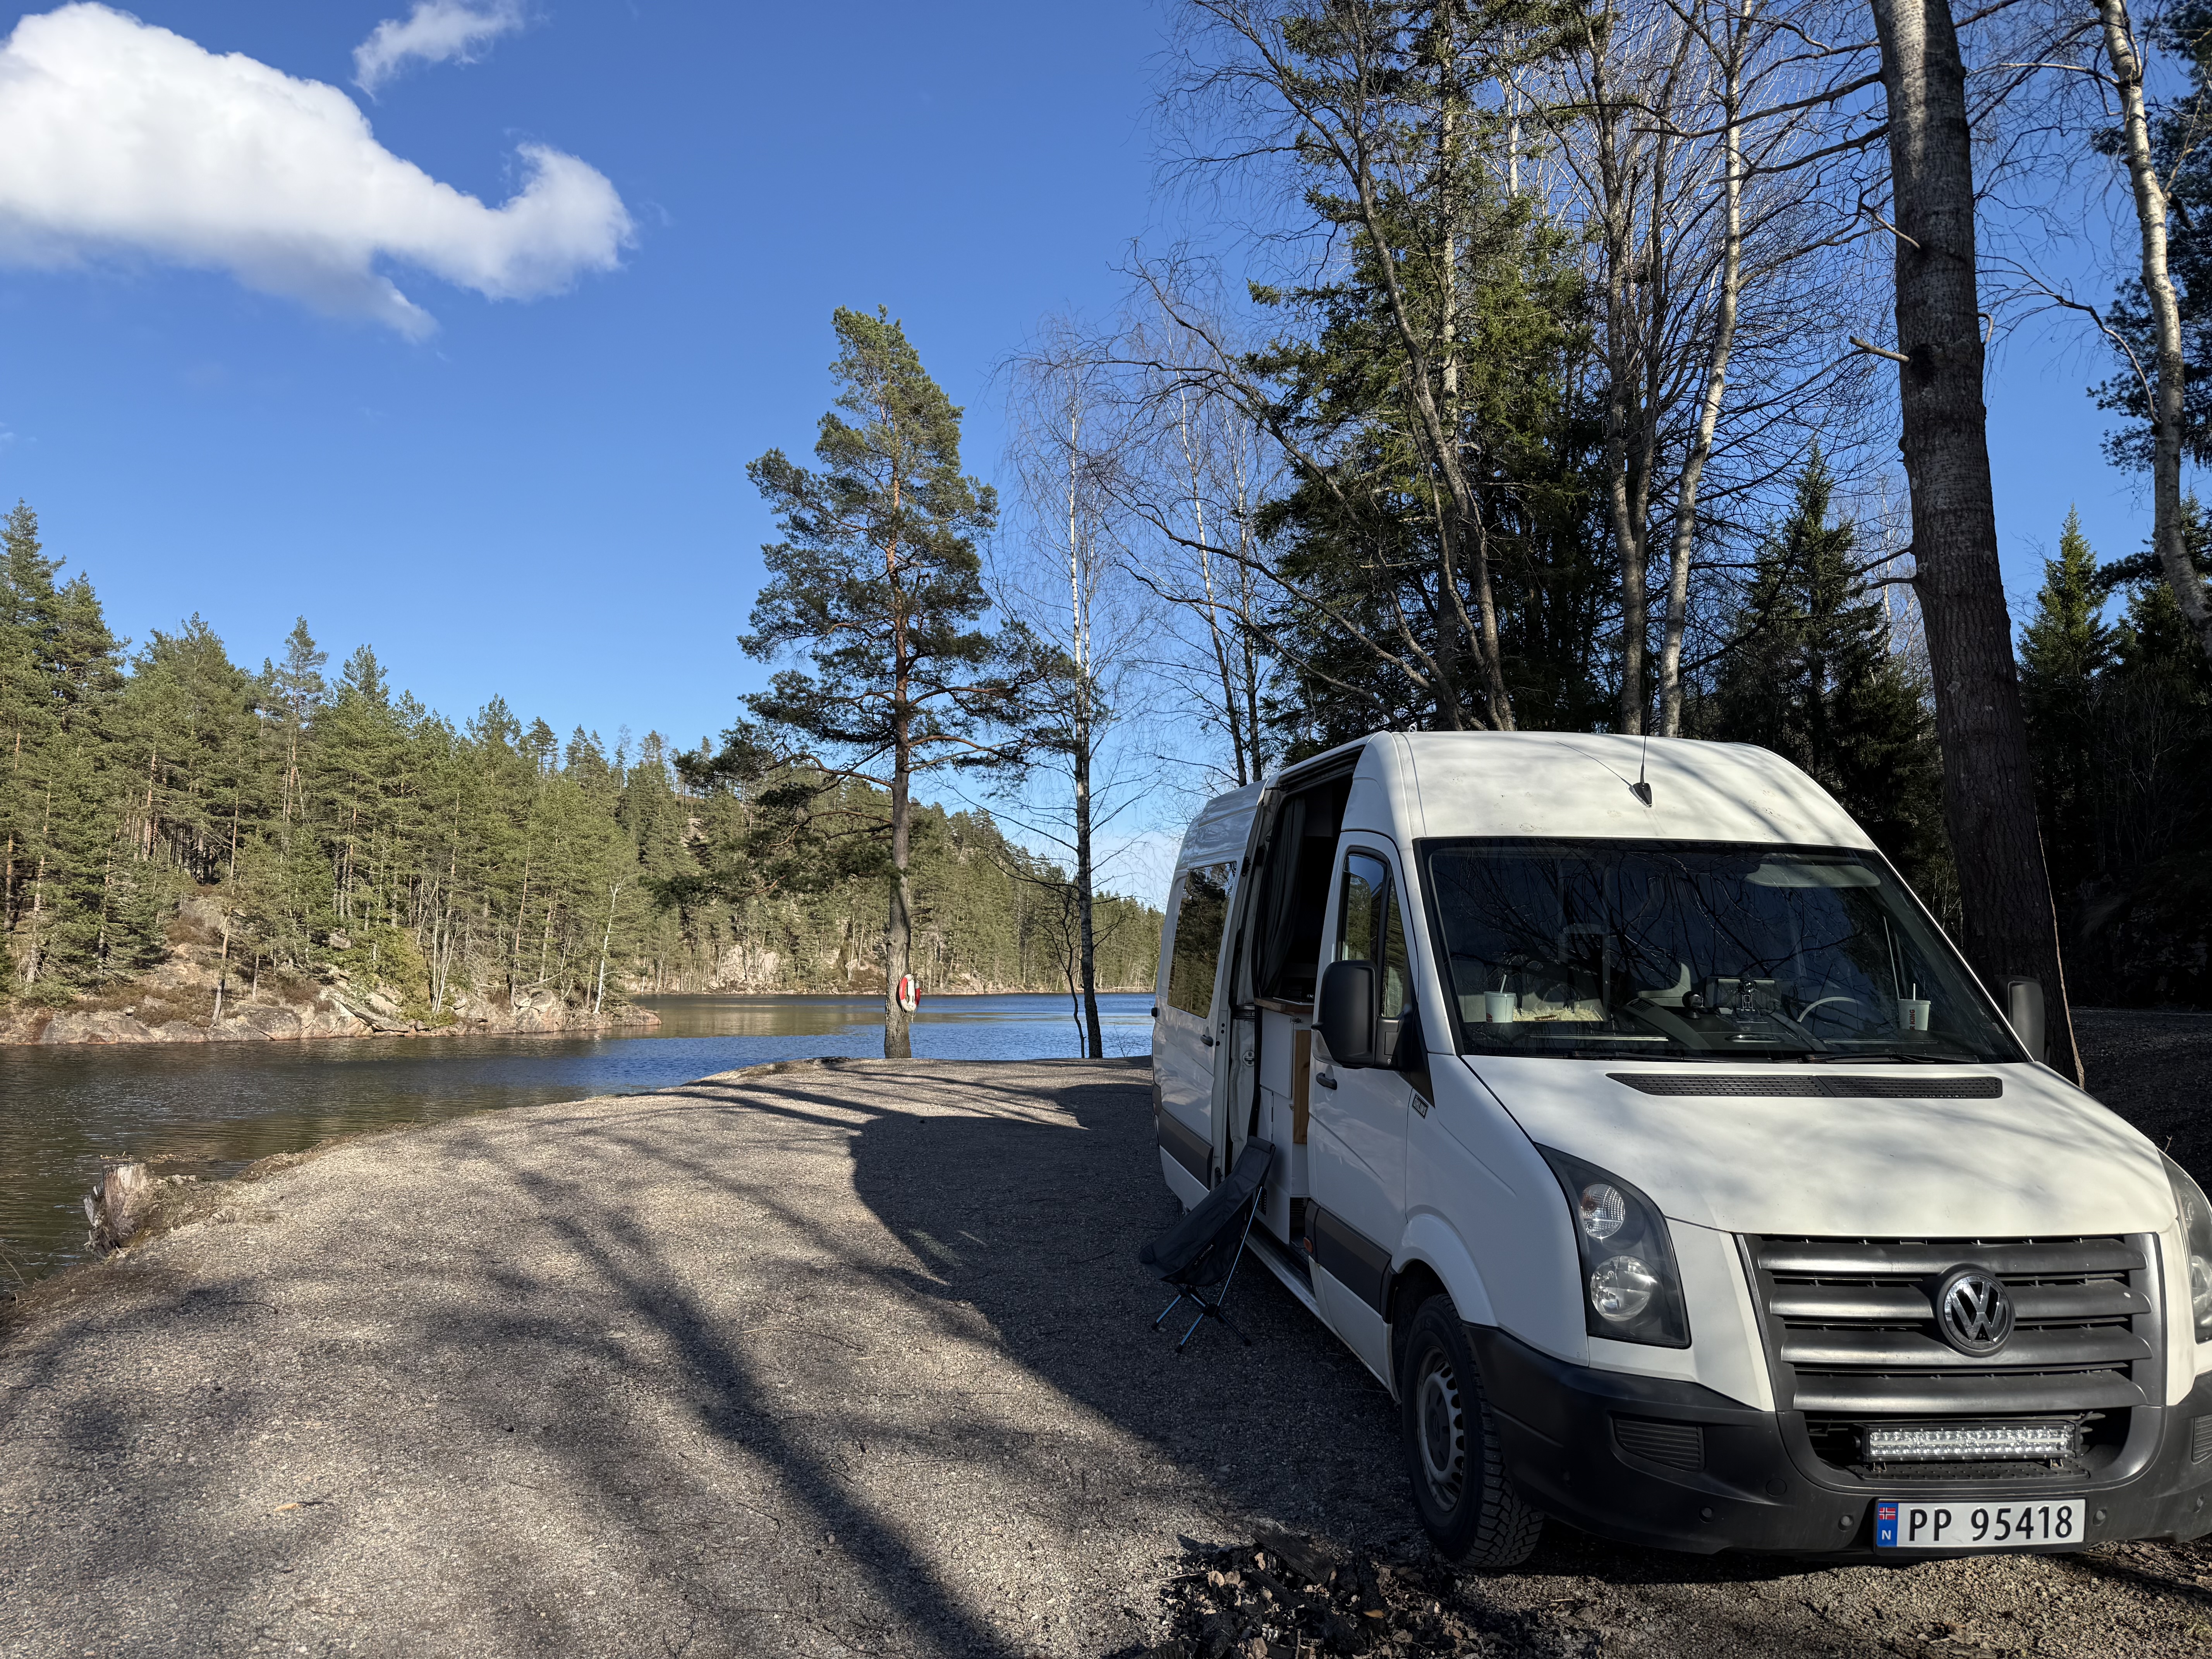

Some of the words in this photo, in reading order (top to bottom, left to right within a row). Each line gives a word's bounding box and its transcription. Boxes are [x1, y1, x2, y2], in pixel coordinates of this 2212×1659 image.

[1945, 1276, 2009, 1347] VW
[1882, 1530, 1891, 1540] N
[1909, 1507, 1952, 1541] PP
[1971, 1505, 2073, 1541] 95418
